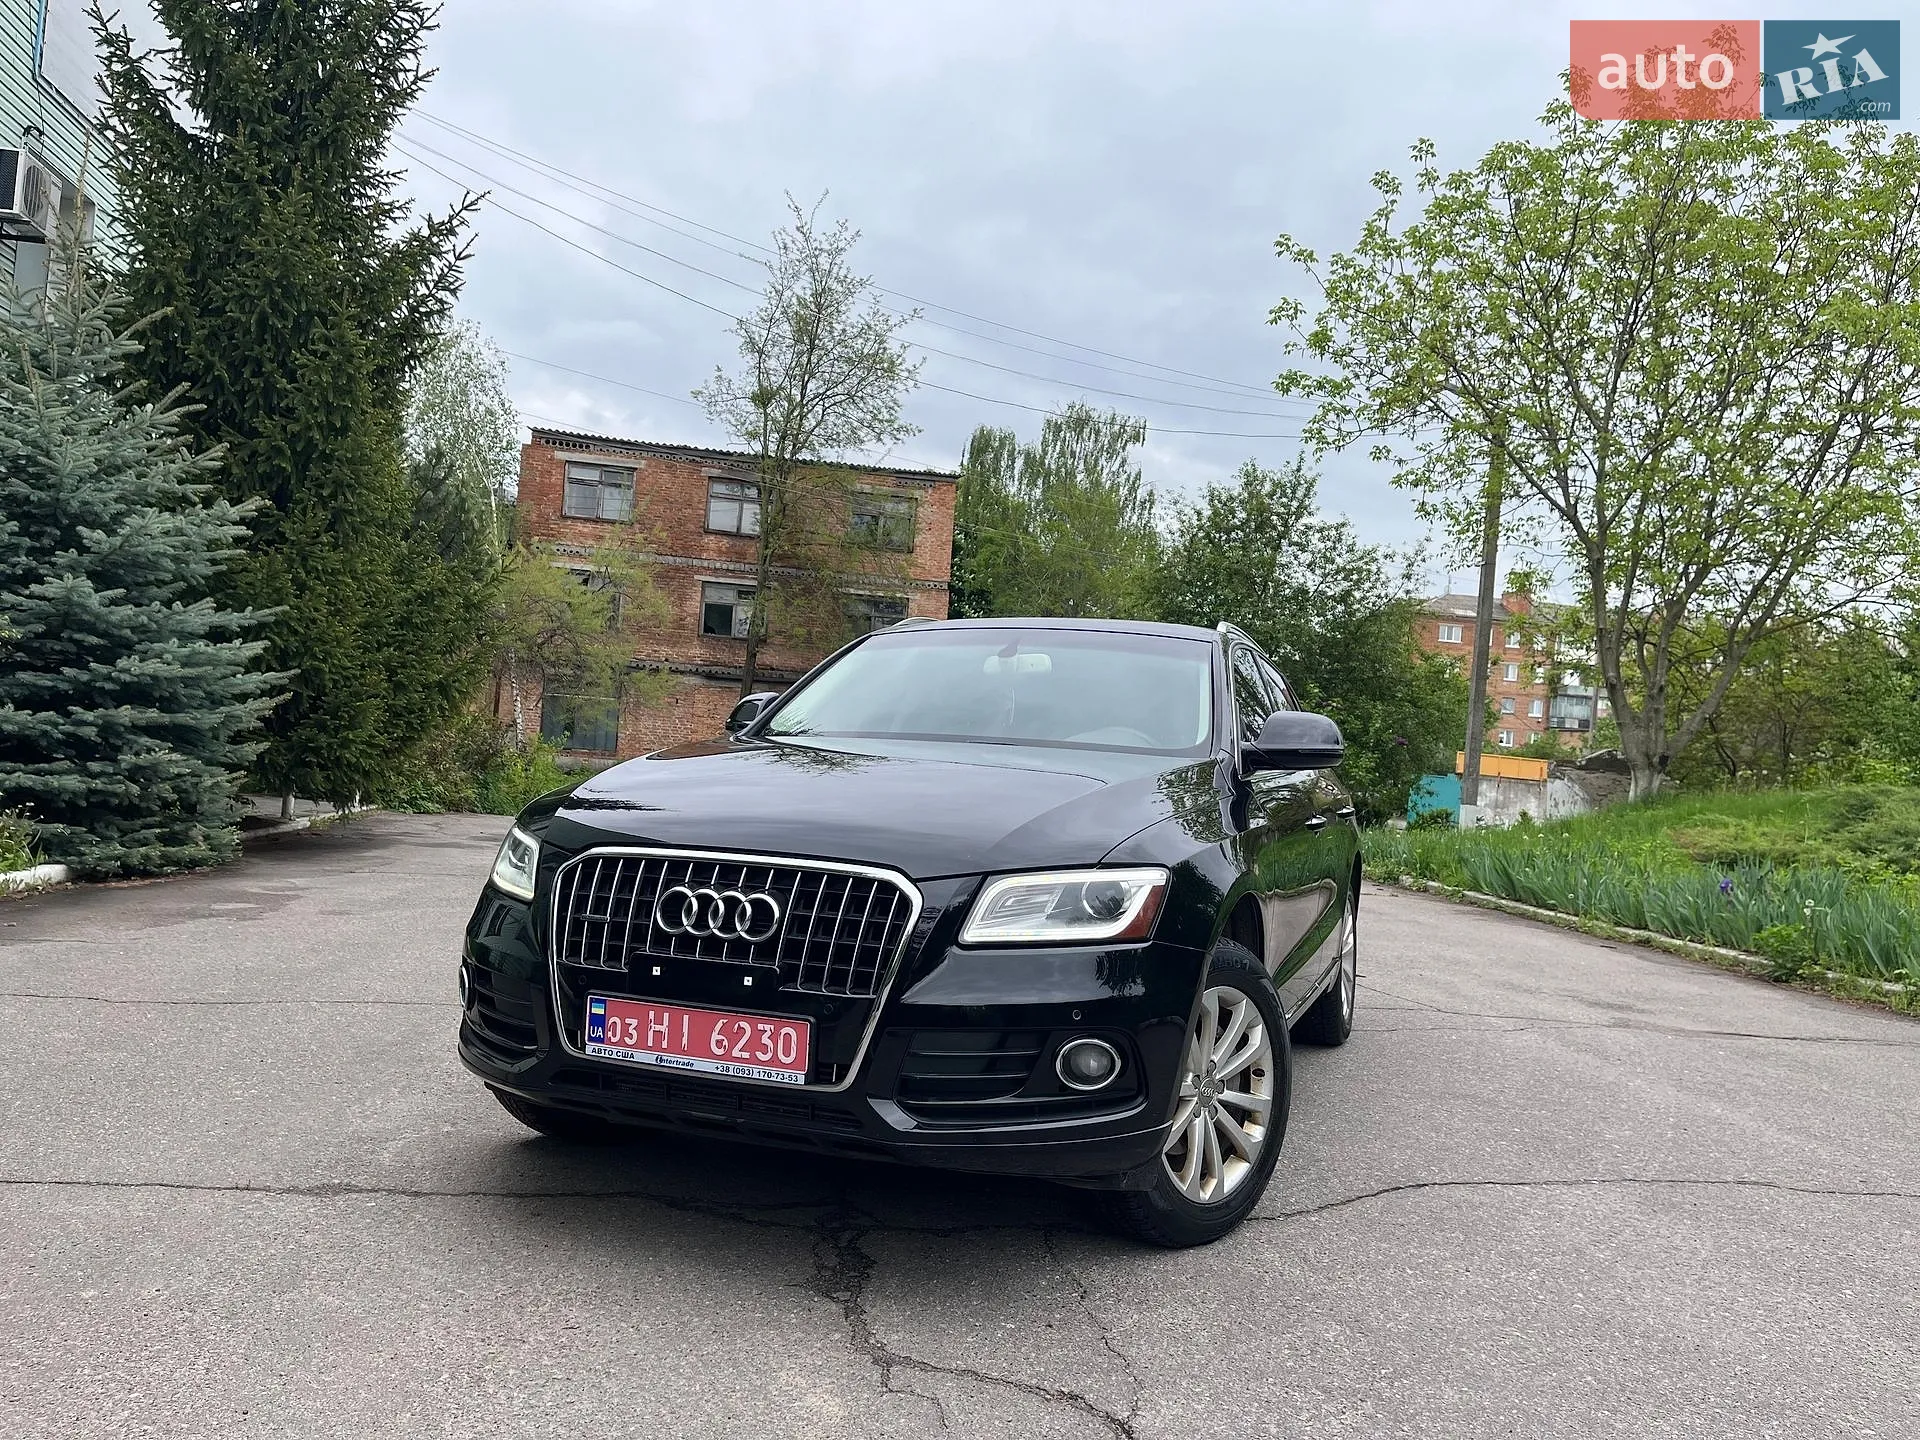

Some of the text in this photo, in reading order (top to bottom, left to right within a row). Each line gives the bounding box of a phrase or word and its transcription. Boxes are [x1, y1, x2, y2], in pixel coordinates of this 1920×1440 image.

[589, 1025, 604, 1039] UA
[710, 1019, 798, 1064] 6230
[715, 1065, 799, 1083] +38 (093) 170-73-53
